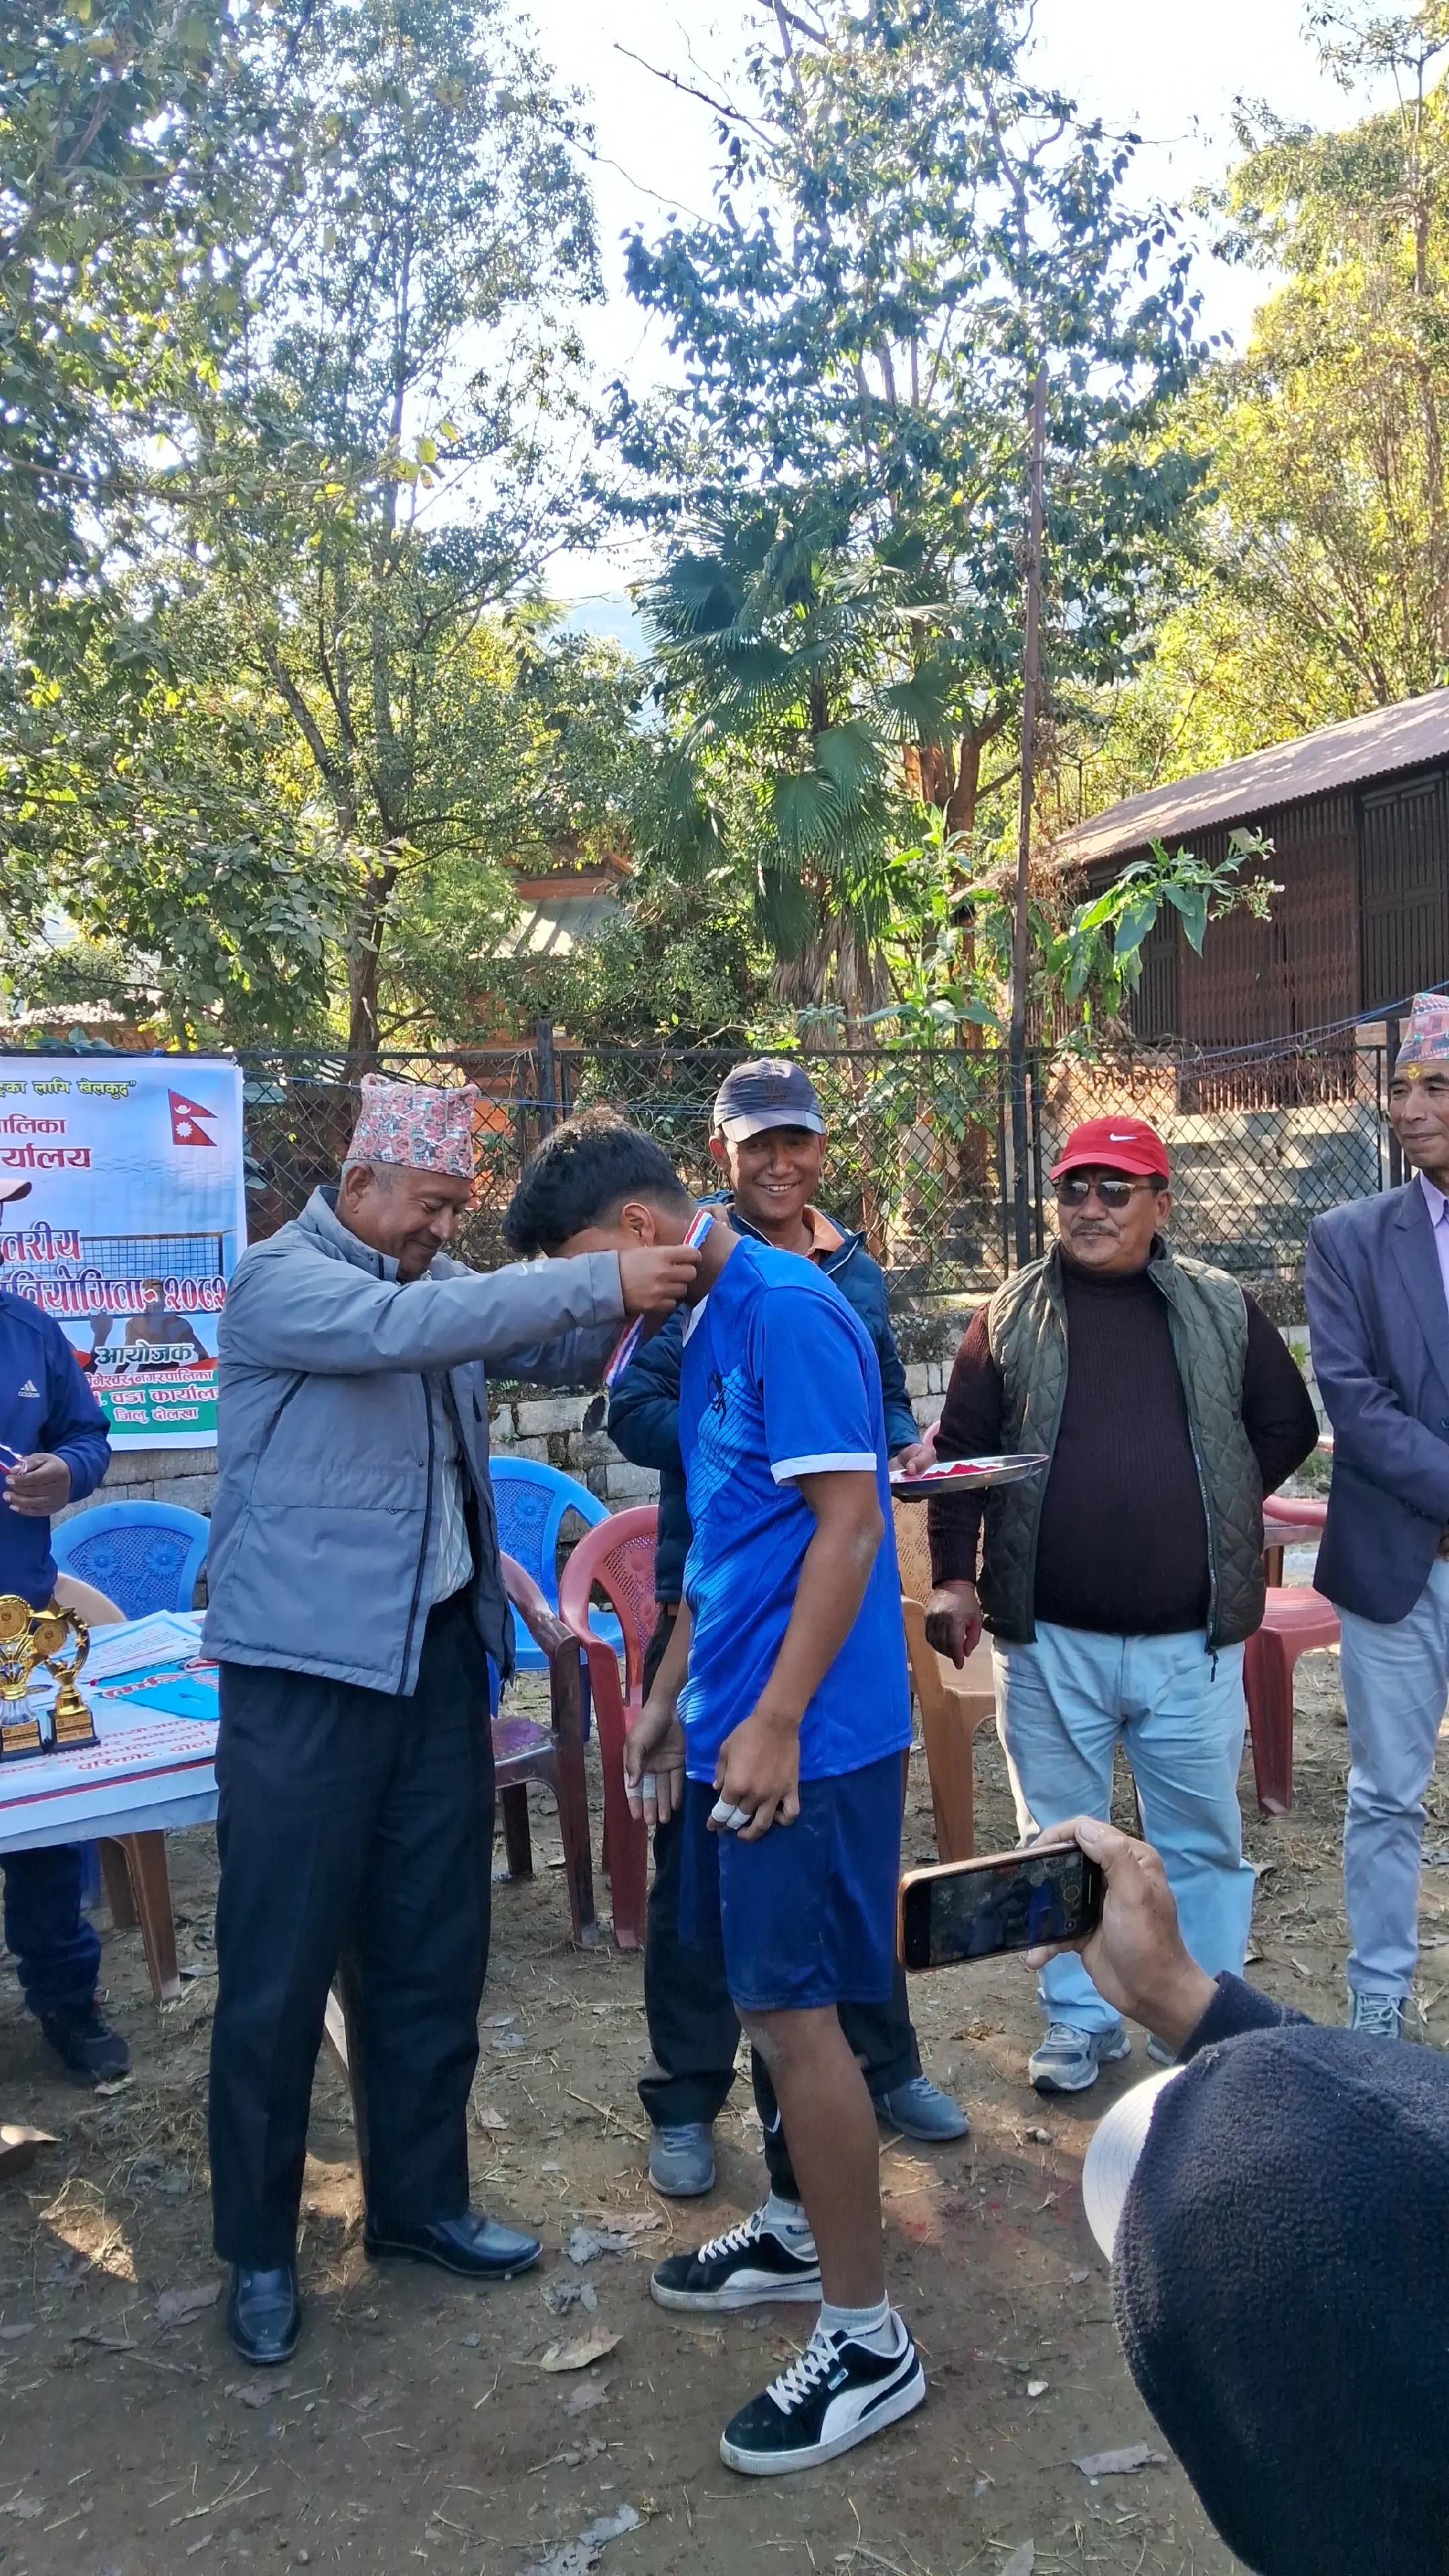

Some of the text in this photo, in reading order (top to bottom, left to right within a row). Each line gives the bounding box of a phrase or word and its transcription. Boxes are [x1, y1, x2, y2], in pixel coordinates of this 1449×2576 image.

[32, 1077, 72, 1095] लागि
[0, 1114, 66, 1134] ालिका
[0, 1142, 91, 1168] र्यालय
[0, 1221, 80, 1261] तरीय
[0, 1265, 227, 1311] तियोगिता- २०८२
[95, 1340, 193, 1364] आयोजक
[85, 1368, 213, 1387] ीमेश्वर नगरपालिका
[110, 1390, 145, 1404] वडा
[150, 1384, 219, 1402] कार्याल
[152, 1405, 199, 1421] दोलखा
